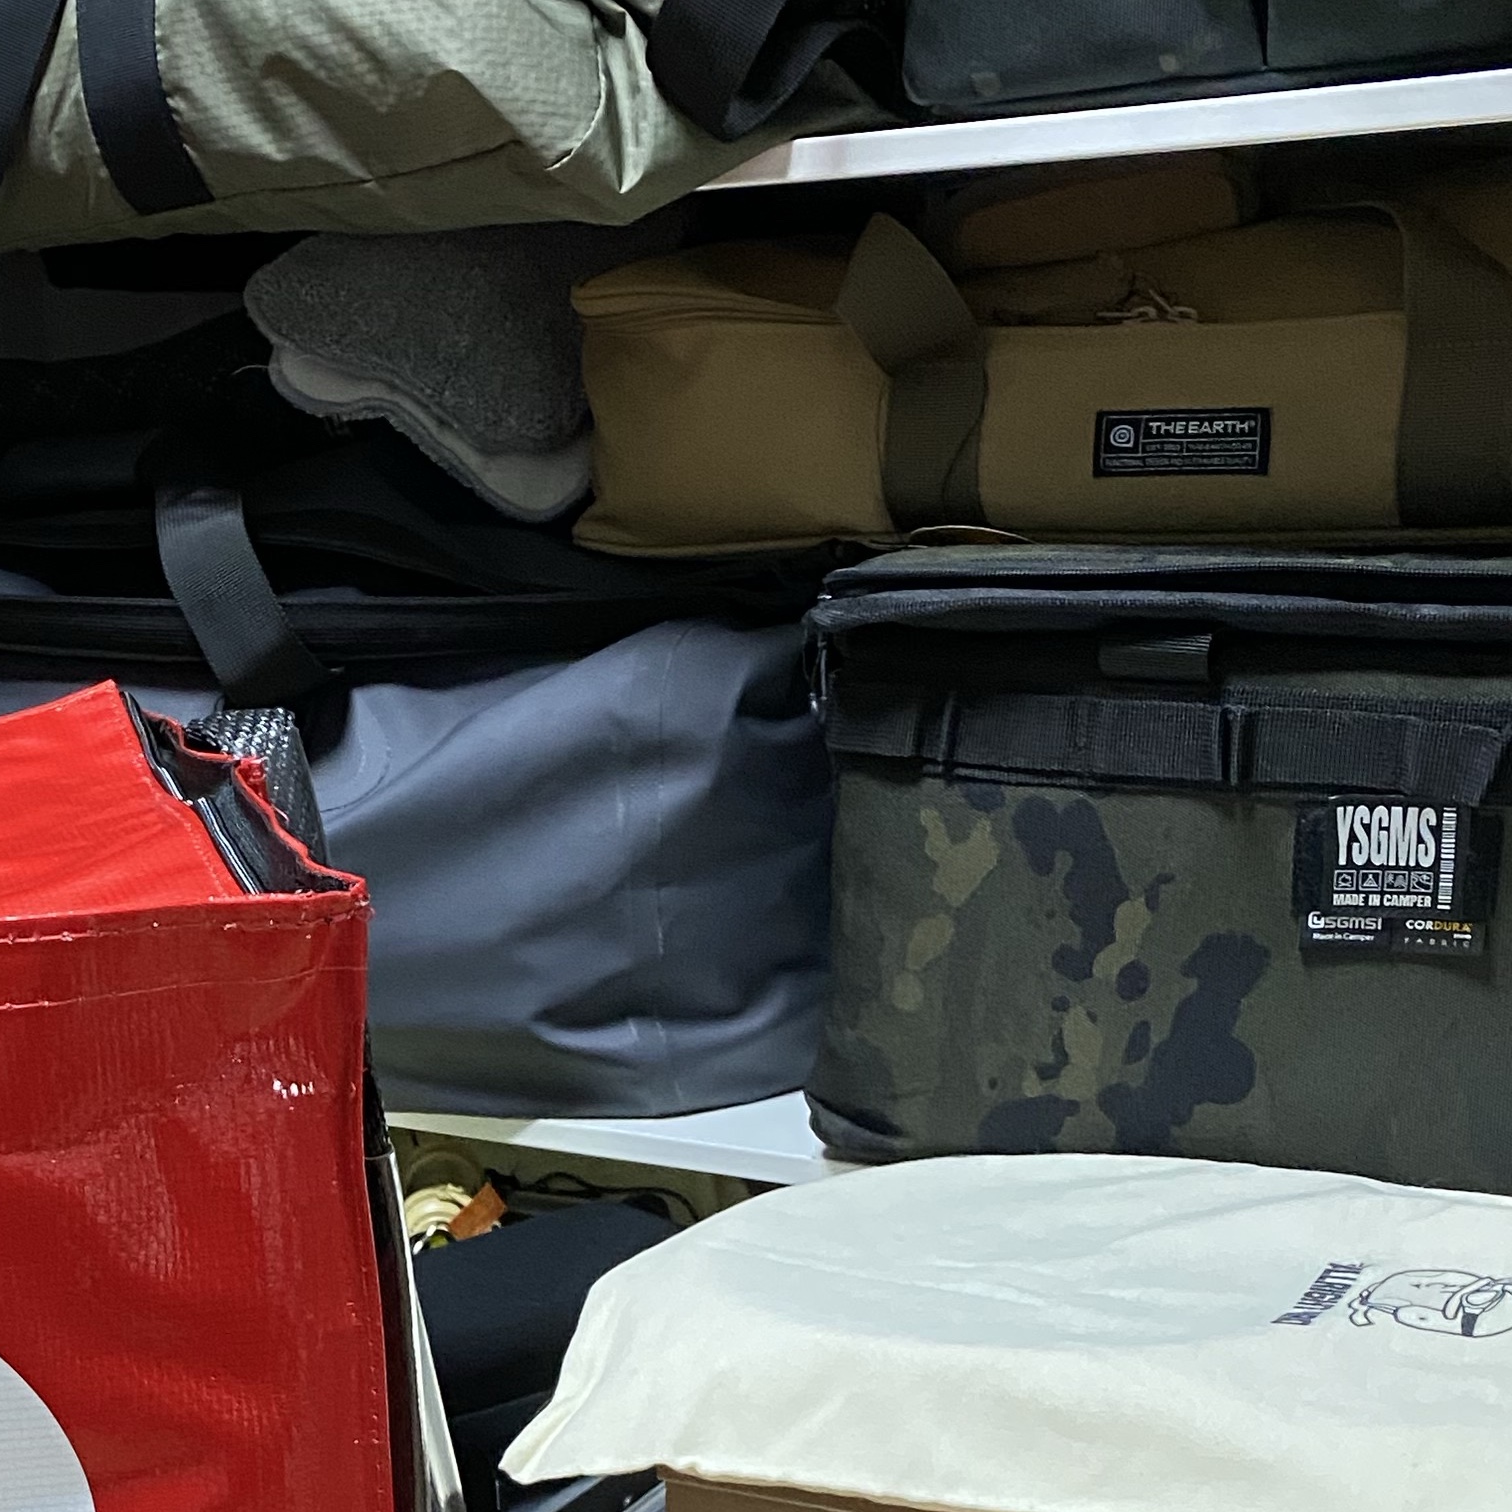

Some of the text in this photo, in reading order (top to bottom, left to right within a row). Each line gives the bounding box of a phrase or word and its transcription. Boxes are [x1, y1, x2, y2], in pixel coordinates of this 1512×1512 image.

[1336, 805, 1437, 868] YSGMS
[1333, 893, 1432, 908] MADE IN CAMPER
